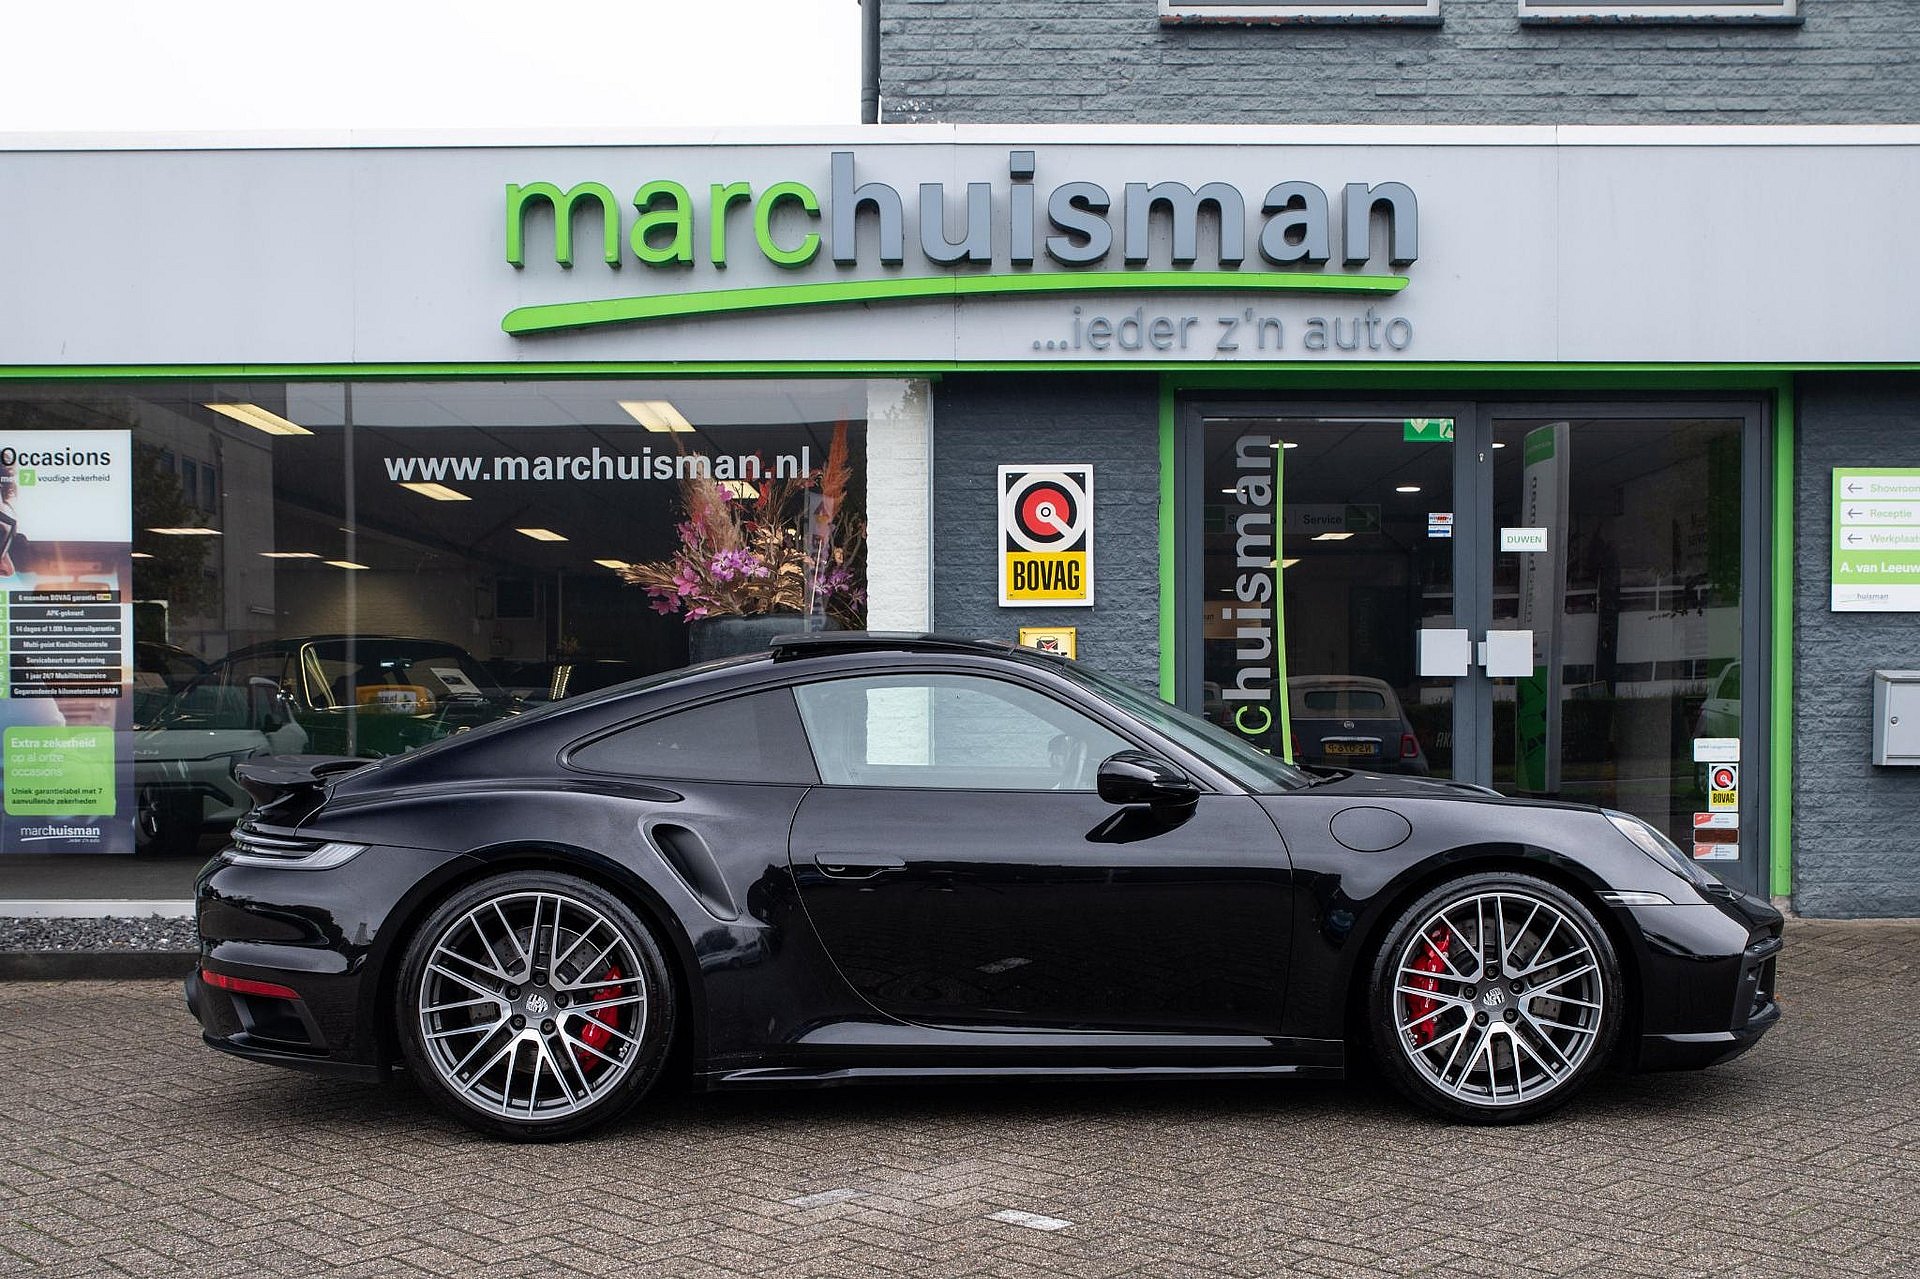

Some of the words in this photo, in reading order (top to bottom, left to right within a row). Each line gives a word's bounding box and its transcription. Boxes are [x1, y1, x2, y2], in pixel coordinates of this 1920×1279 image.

[505, 151, 1418, 268] marchuisman
[1032, 306, 1198, 352] ...ieder
[1216, 307, 1285, 351] z'n
[1303, 309, 1414, 351] auto
[0, 447, 111, 466] Occasions
[384, 446, 811, 481] www.marchuisman.nl
[38, 475, 70, 483] voudige
[72, 474, 110, 482] zekerheid
[1303, 514, 1342, 525] Service
[1870, 509, 1912, 519] Receptie
[1507, 535, 1542, 544] DUWEN
[1840, 561, 1853, 573] A.
[1856, 564, 1878, 573] van
[1013, 560, 1080, 591] BOVAG
[1222, 435, 1272, 754] chuisman
[11, 738, 40, 748] Extra
[43, 737, 96, 748] zekerheid
[1712, 792, 1735, 804] BOVAG
[20, 825, 100, 836] marchuisman
